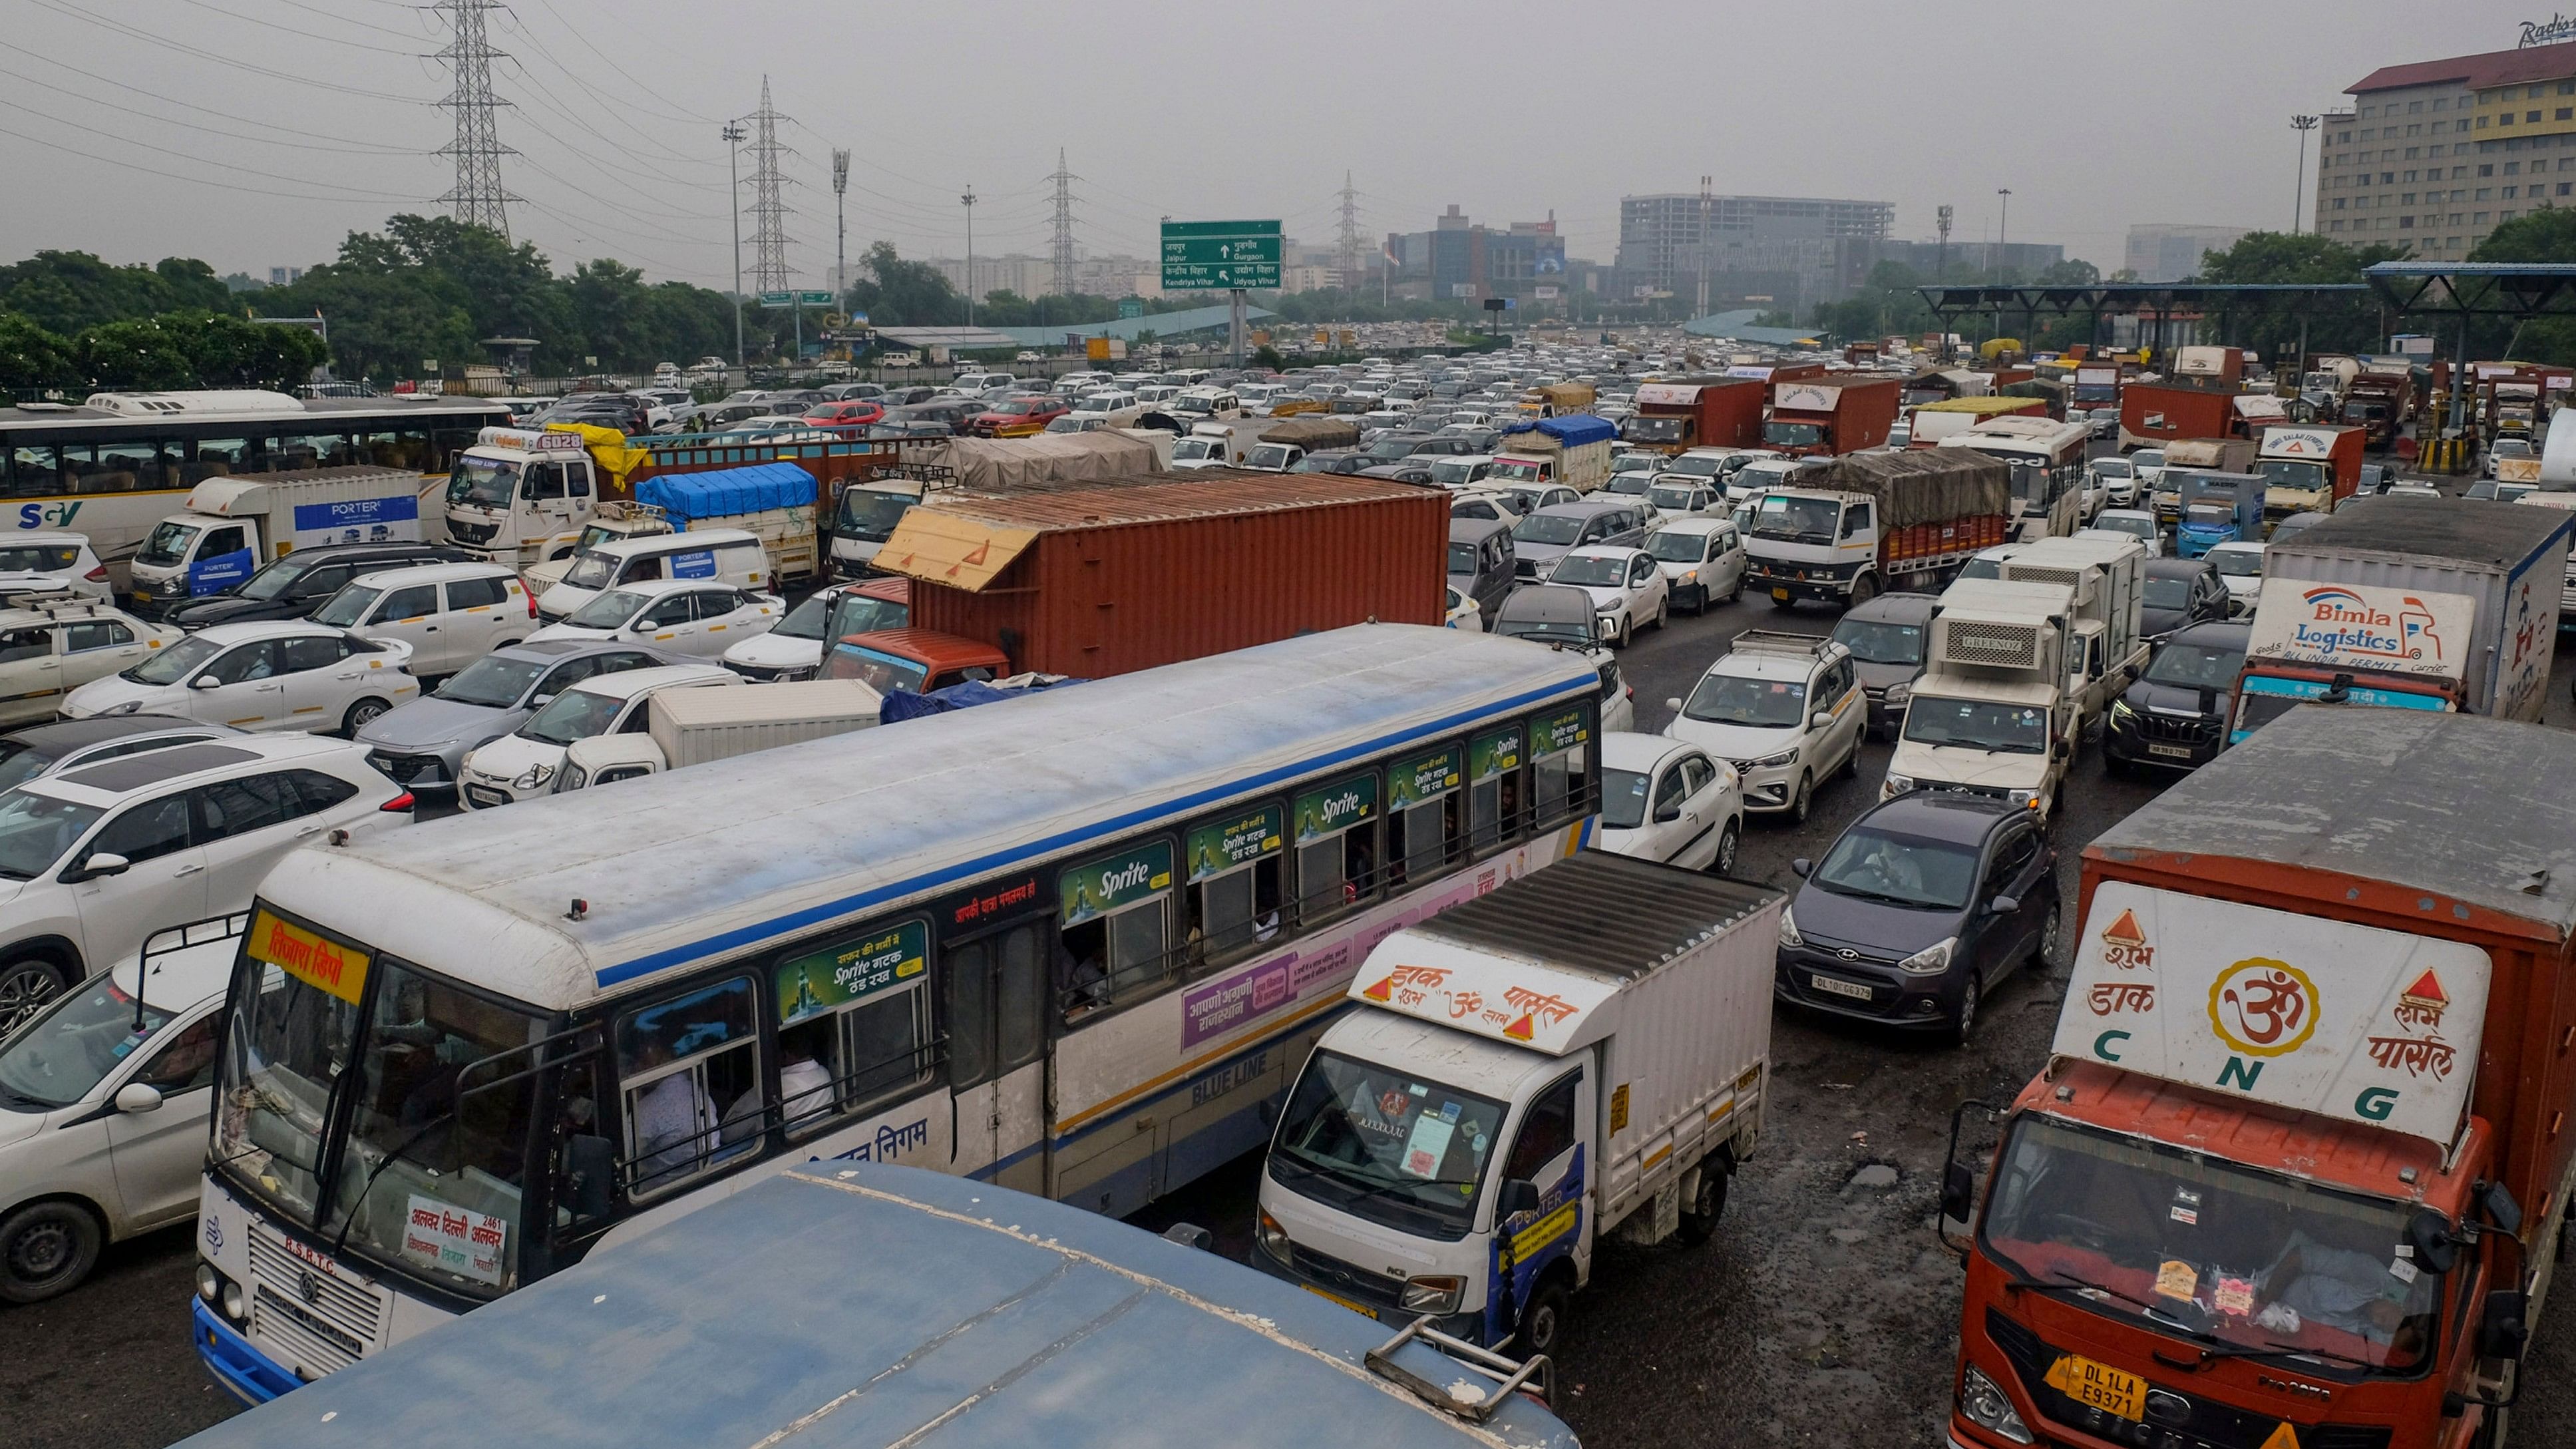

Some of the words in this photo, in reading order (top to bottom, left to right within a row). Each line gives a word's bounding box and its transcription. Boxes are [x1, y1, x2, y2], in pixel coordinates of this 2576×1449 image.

[1234, 254, 1264, 262] Gurgaon
[1783, 388, 1802, 403] BALAJI
[1805, 387, 1827, 406] LOGISTICS
[542, 435, 581, 449] 6028
[333, 502, 378, 515] PORTER
[205, 563, 232, 572] PORTER
[2314, 603, 2391, 626] Bimla
[1965, 638, 2020, 650] GREENOZ
[2256, 642, 2283, 654] Goods
[2296, 624, 2398, 654] Logistics
[2284, 651, 2300, 660] ALL
[2306, 652, 2338, 665] INDIA
[2348, 658, 2401, 670] PERMIT
[1497, 737, 1519, 756] Sprite
[1415, 770, 1433, 787] Sprite
[1321, 791, 1359, 823] Sprite
[1222, 835, 1246, 854] Sprite
[1246, 828, 1266, 842] गटक
[1244, 843, 1258, 855] रख
[1099, 861, 1149, 899] Sprite
[862, 942, 874, 954] की
[834, 956, 870, 985] Sprite
[872, 950, 903, 969] गटक
[1390, 964, 1453, 988] डाक
[848, 976, 866, 994] ठंड
[870, 969, 890, 985] रख
[1503, 985, 1580, 1030] पार्सल
[2087, 983, 2155, 1016] डाक
[1198, 1000, 1244, 1032] राजस्थान
[2368, 1034, 2458, 1082] पार्सल
[1192, 1069, 1230, 1108] BLUE
[1234, 1052, 1266, 1086] LINE
[2093, 1030, 2131, 1062] C
[2215, 1056, 2265, 1091] N
[2354, 1086, 2400, 1122] G
[875, 1118, 928, 1162] निगम
[1358, 1118, 1405, 1138] MAHAKAAL
[412, 1208, 440, 1231] अलवर
[442, 1210, 468, 1239] दिल्ली
[471, 1226, 502, 1247] अलवर
[483, 1215, 501, 1230] 2461
[285, 1235, 337, 1277] R.S.R.T.C.
[260, 1287, 299, 1316] ASHOK
[299, 1311, 360, 1352] LEYLAND
[2085, 1364, 2134, 1396] DL1LA
[2082, 1384, 2132, 1415] E9371
